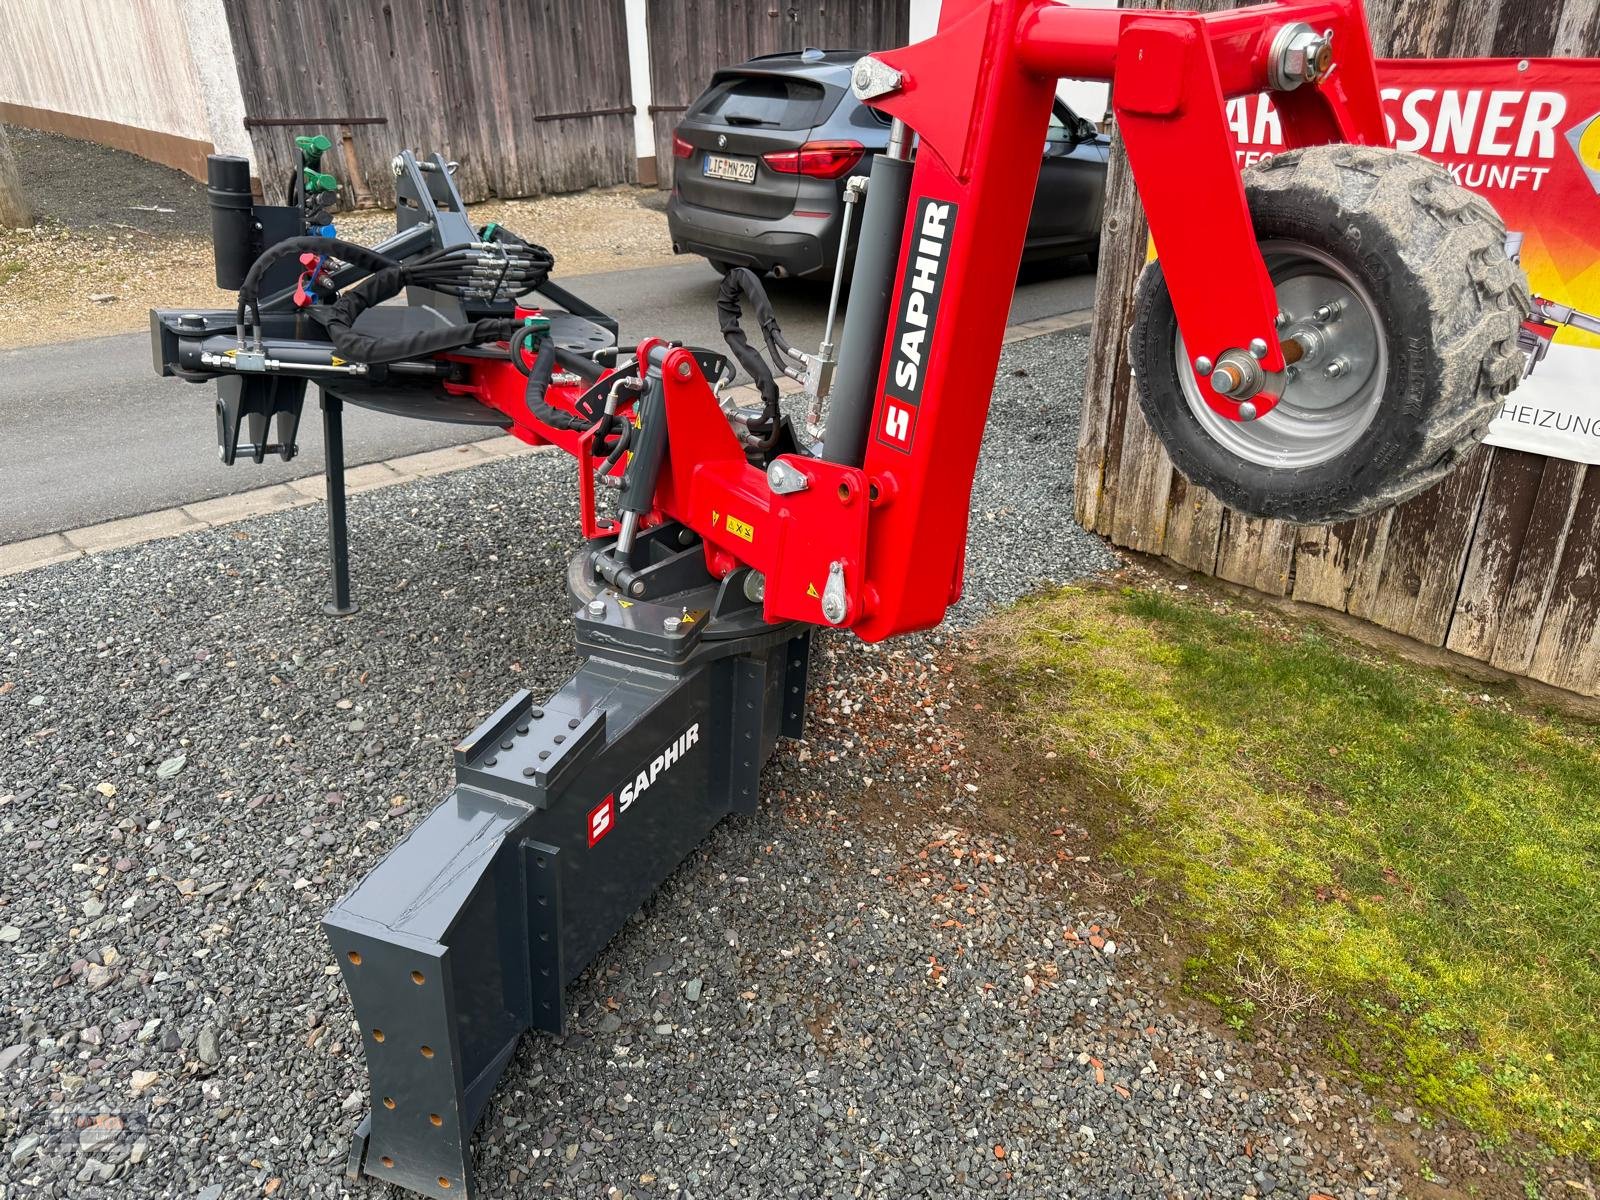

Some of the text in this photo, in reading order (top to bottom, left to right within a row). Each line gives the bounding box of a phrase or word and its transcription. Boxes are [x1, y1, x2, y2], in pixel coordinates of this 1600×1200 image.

[739, 164, 754, 178] 228
[1441, 162, 1550, 191] KUNFT
[895, 202, 949, 391] SAPHIR
[619, 722, 699, 814] SAPHIR
